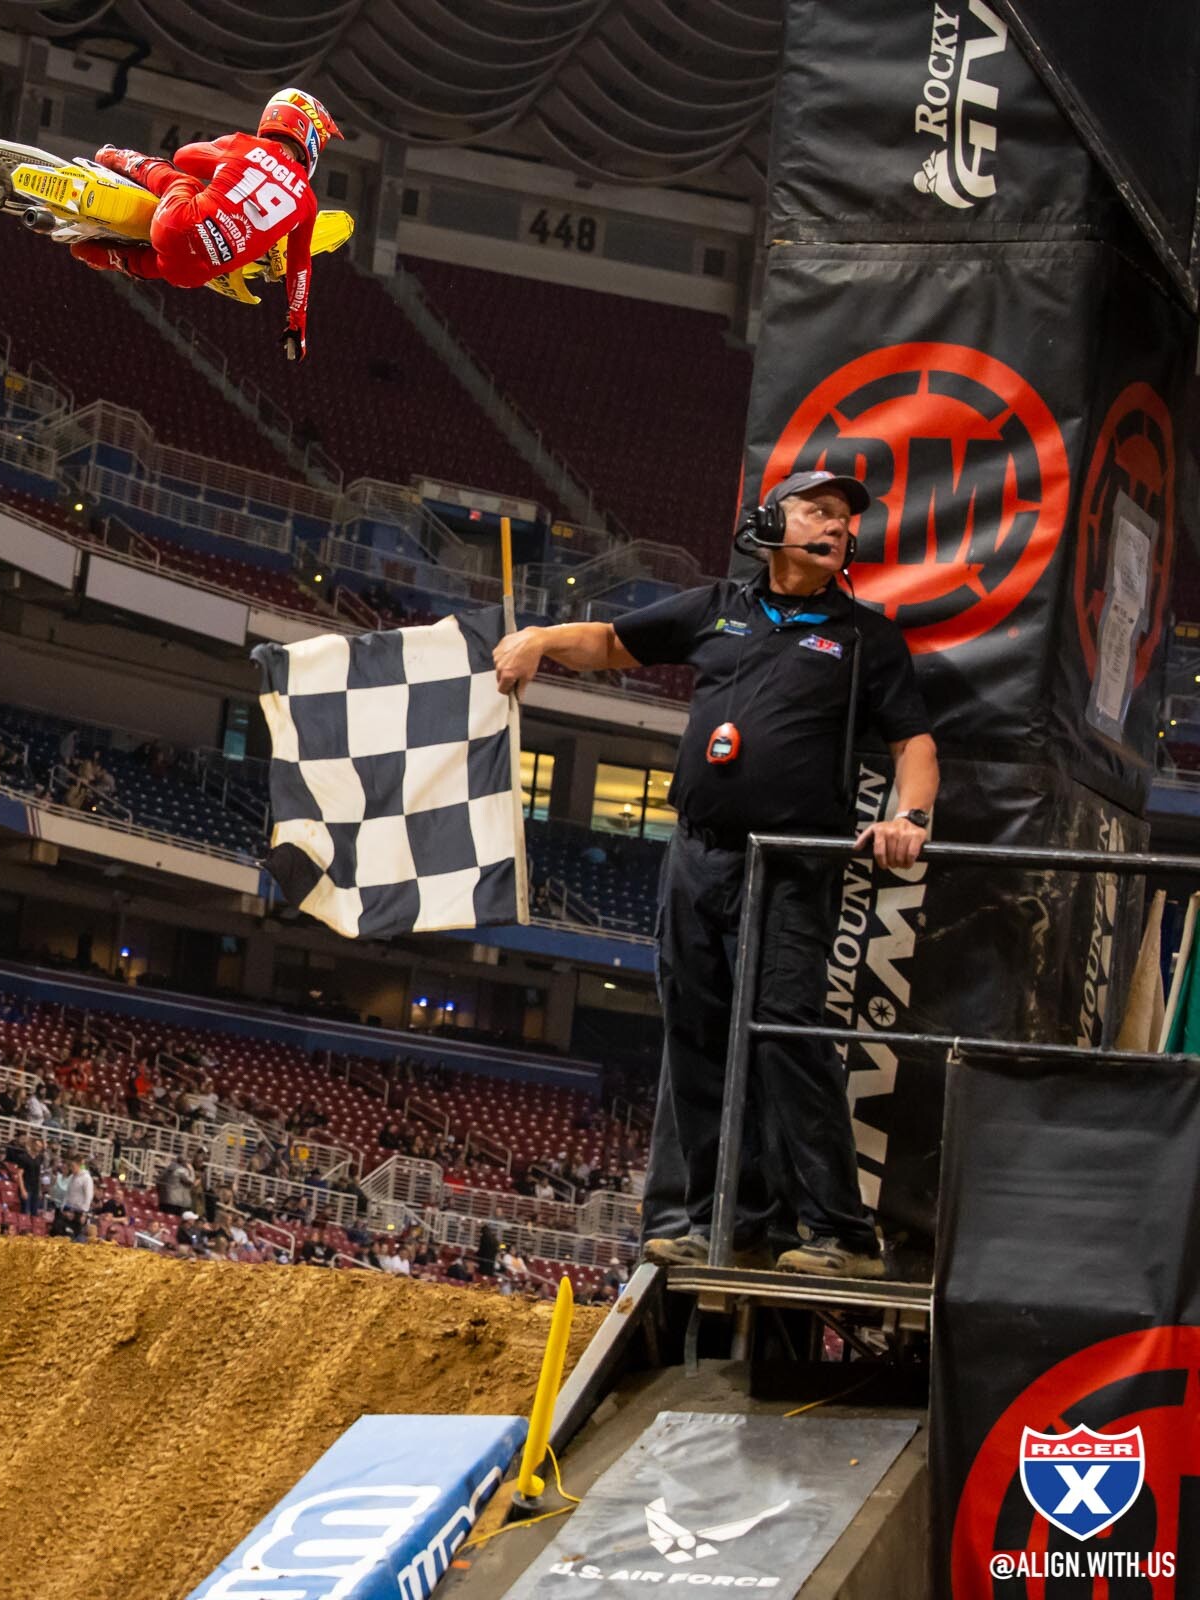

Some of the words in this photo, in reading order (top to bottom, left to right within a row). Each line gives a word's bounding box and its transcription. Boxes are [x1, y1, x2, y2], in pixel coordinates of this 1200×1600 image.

[914, 2, 960, 142] ROCKY
[243, 146, 307, 199] BOGLE
[224, 166, 297, 232] 19
[204, 219, 232, 262] SUZUKI
[215, 208, 242, 240] TWISTED
[235, 235, 246, 254] TEA
[529, 209, 597, 253] 448
[549, 1561, 605, 1581] U.S.
[608, 1569, 665, 1583] AIR
[667, 1572, 781, 1588] FORCE
